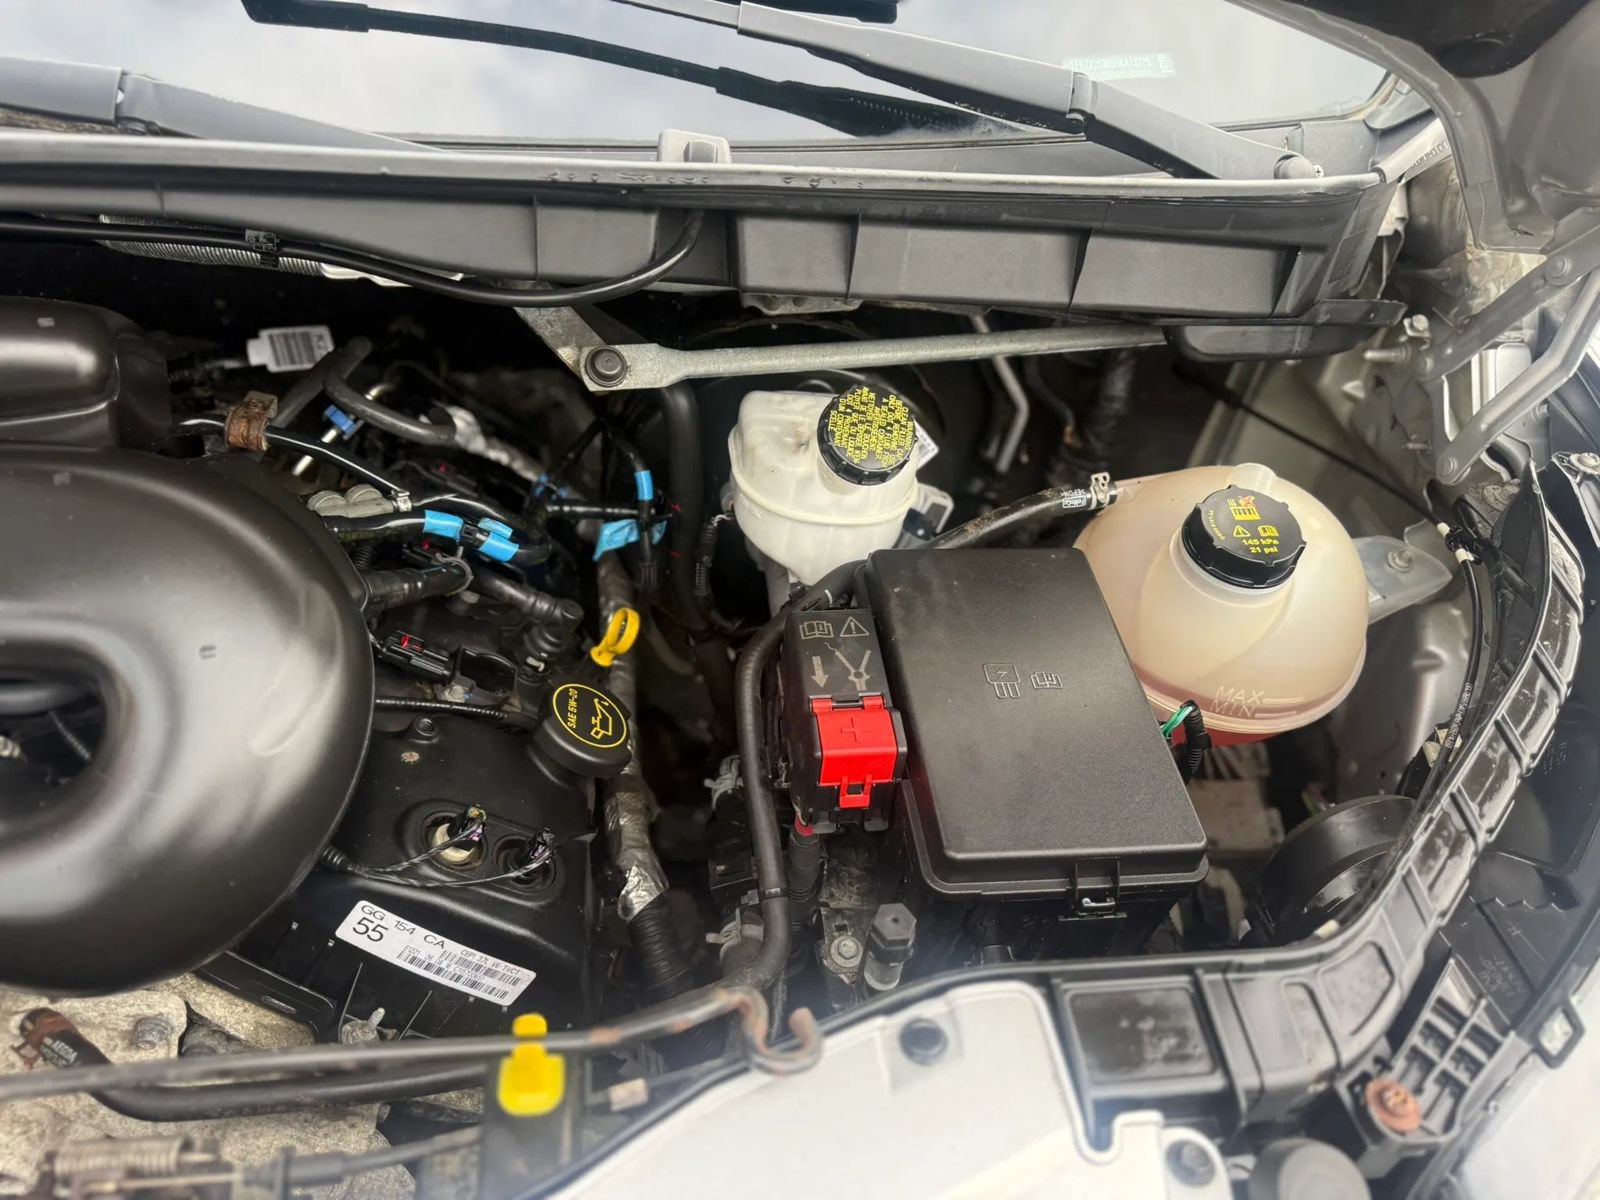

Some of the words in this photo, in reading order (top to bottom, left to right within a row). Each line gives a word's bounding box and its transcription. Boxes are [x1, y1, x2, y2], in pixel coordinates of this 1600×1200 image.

[1249, 546, 1262, 554] 21
[1263, 546, 1279, 554] psi
[568, 688, 578, 713] 5W-20
[1215, 686, 1264, 705] MAX
[1209, 699, 1256, 718] MIN
[567, 712, 577, 729] SAE
[352, 916, 389, 943] 55
[361, 904, 386, 921] GG
[394, 920, 417, 936] 154
[423, 934, 446, 950] CA
